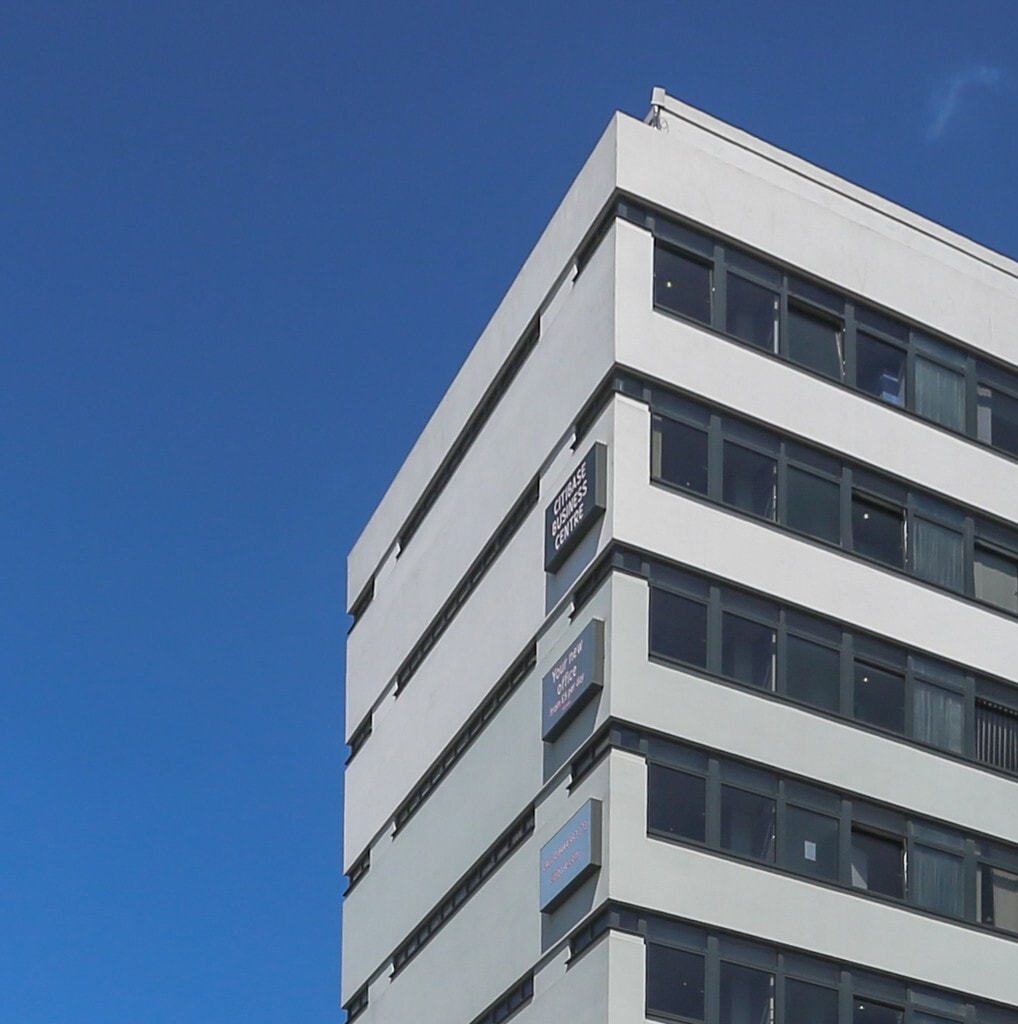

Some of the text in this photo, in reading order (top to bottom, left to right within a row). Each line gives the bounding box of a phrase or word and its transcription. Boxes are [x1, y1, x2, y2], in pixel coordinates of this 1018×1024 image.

[552, 479, 588, 537] BUSINESS
[553, 461, 587, 515] CITIBASE
[555, 502, 584, 550] CENTRE
[568, 639, 584, 664] new
[557, 665, 577, 695] office
